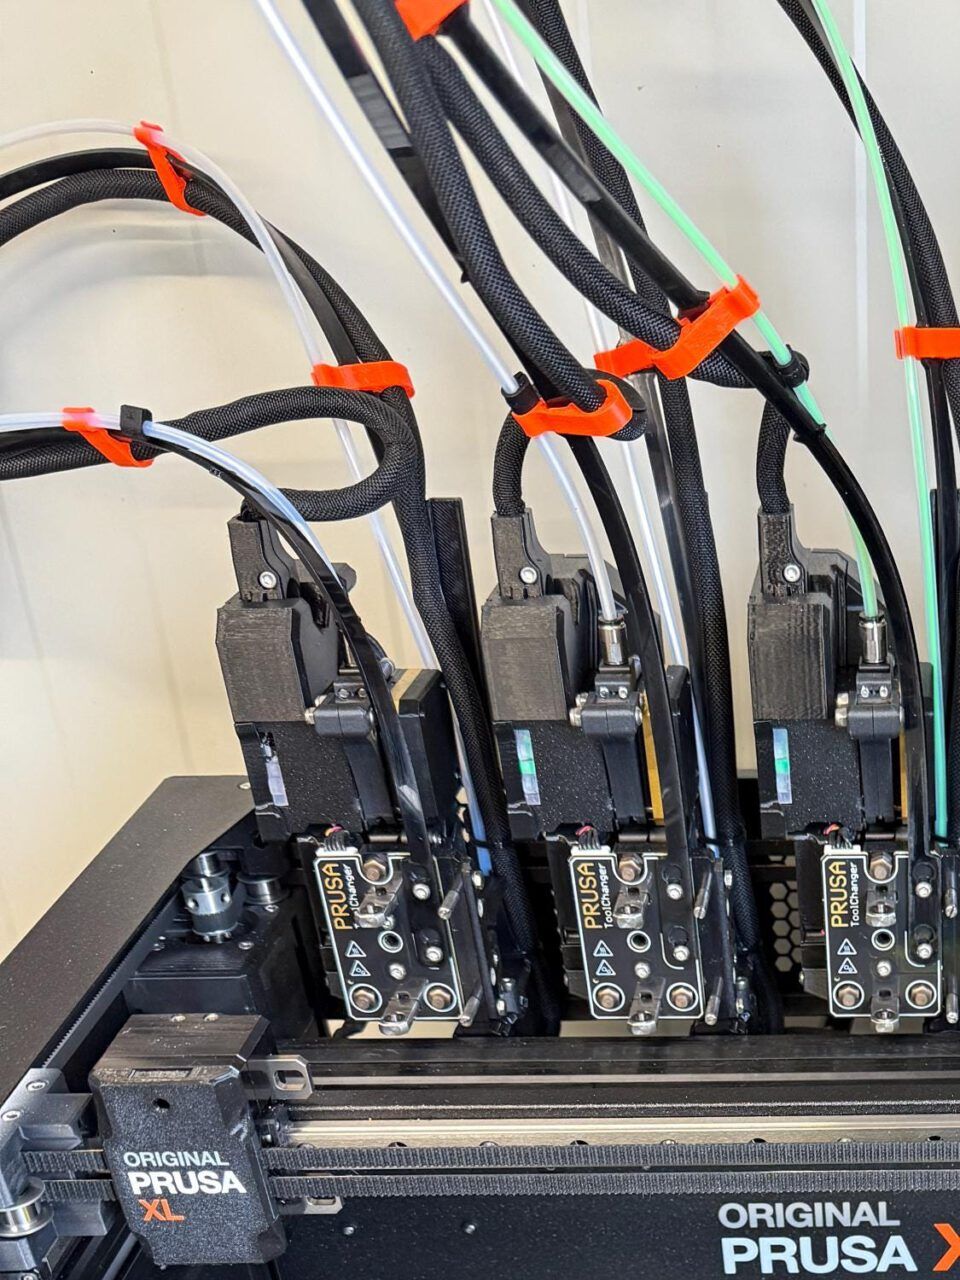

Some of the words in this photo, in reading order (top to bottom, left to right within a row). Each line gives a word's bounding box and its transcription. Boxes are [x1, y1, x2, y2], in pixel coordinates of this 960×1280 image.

[322, 863, 353, 930] PRUSA
[342, 863, 361, 930] TlChanger
[577, 862, 603, 930] PRUSA
[598, 862, 614, 929] ToolChanger
[829, 861, 849, 928] PRUSA
[850, 861, 860, 928] ToolChanger
[123, 1150, 230, 1167] ORIGINAL
[127, 1170, 247, 1195] PRUSA
[138, 1198, 185, 1222] XL
[718, 1201, 900, 1229] ORIGINAL
[721, 1235, 918, 1274] PRUSA
